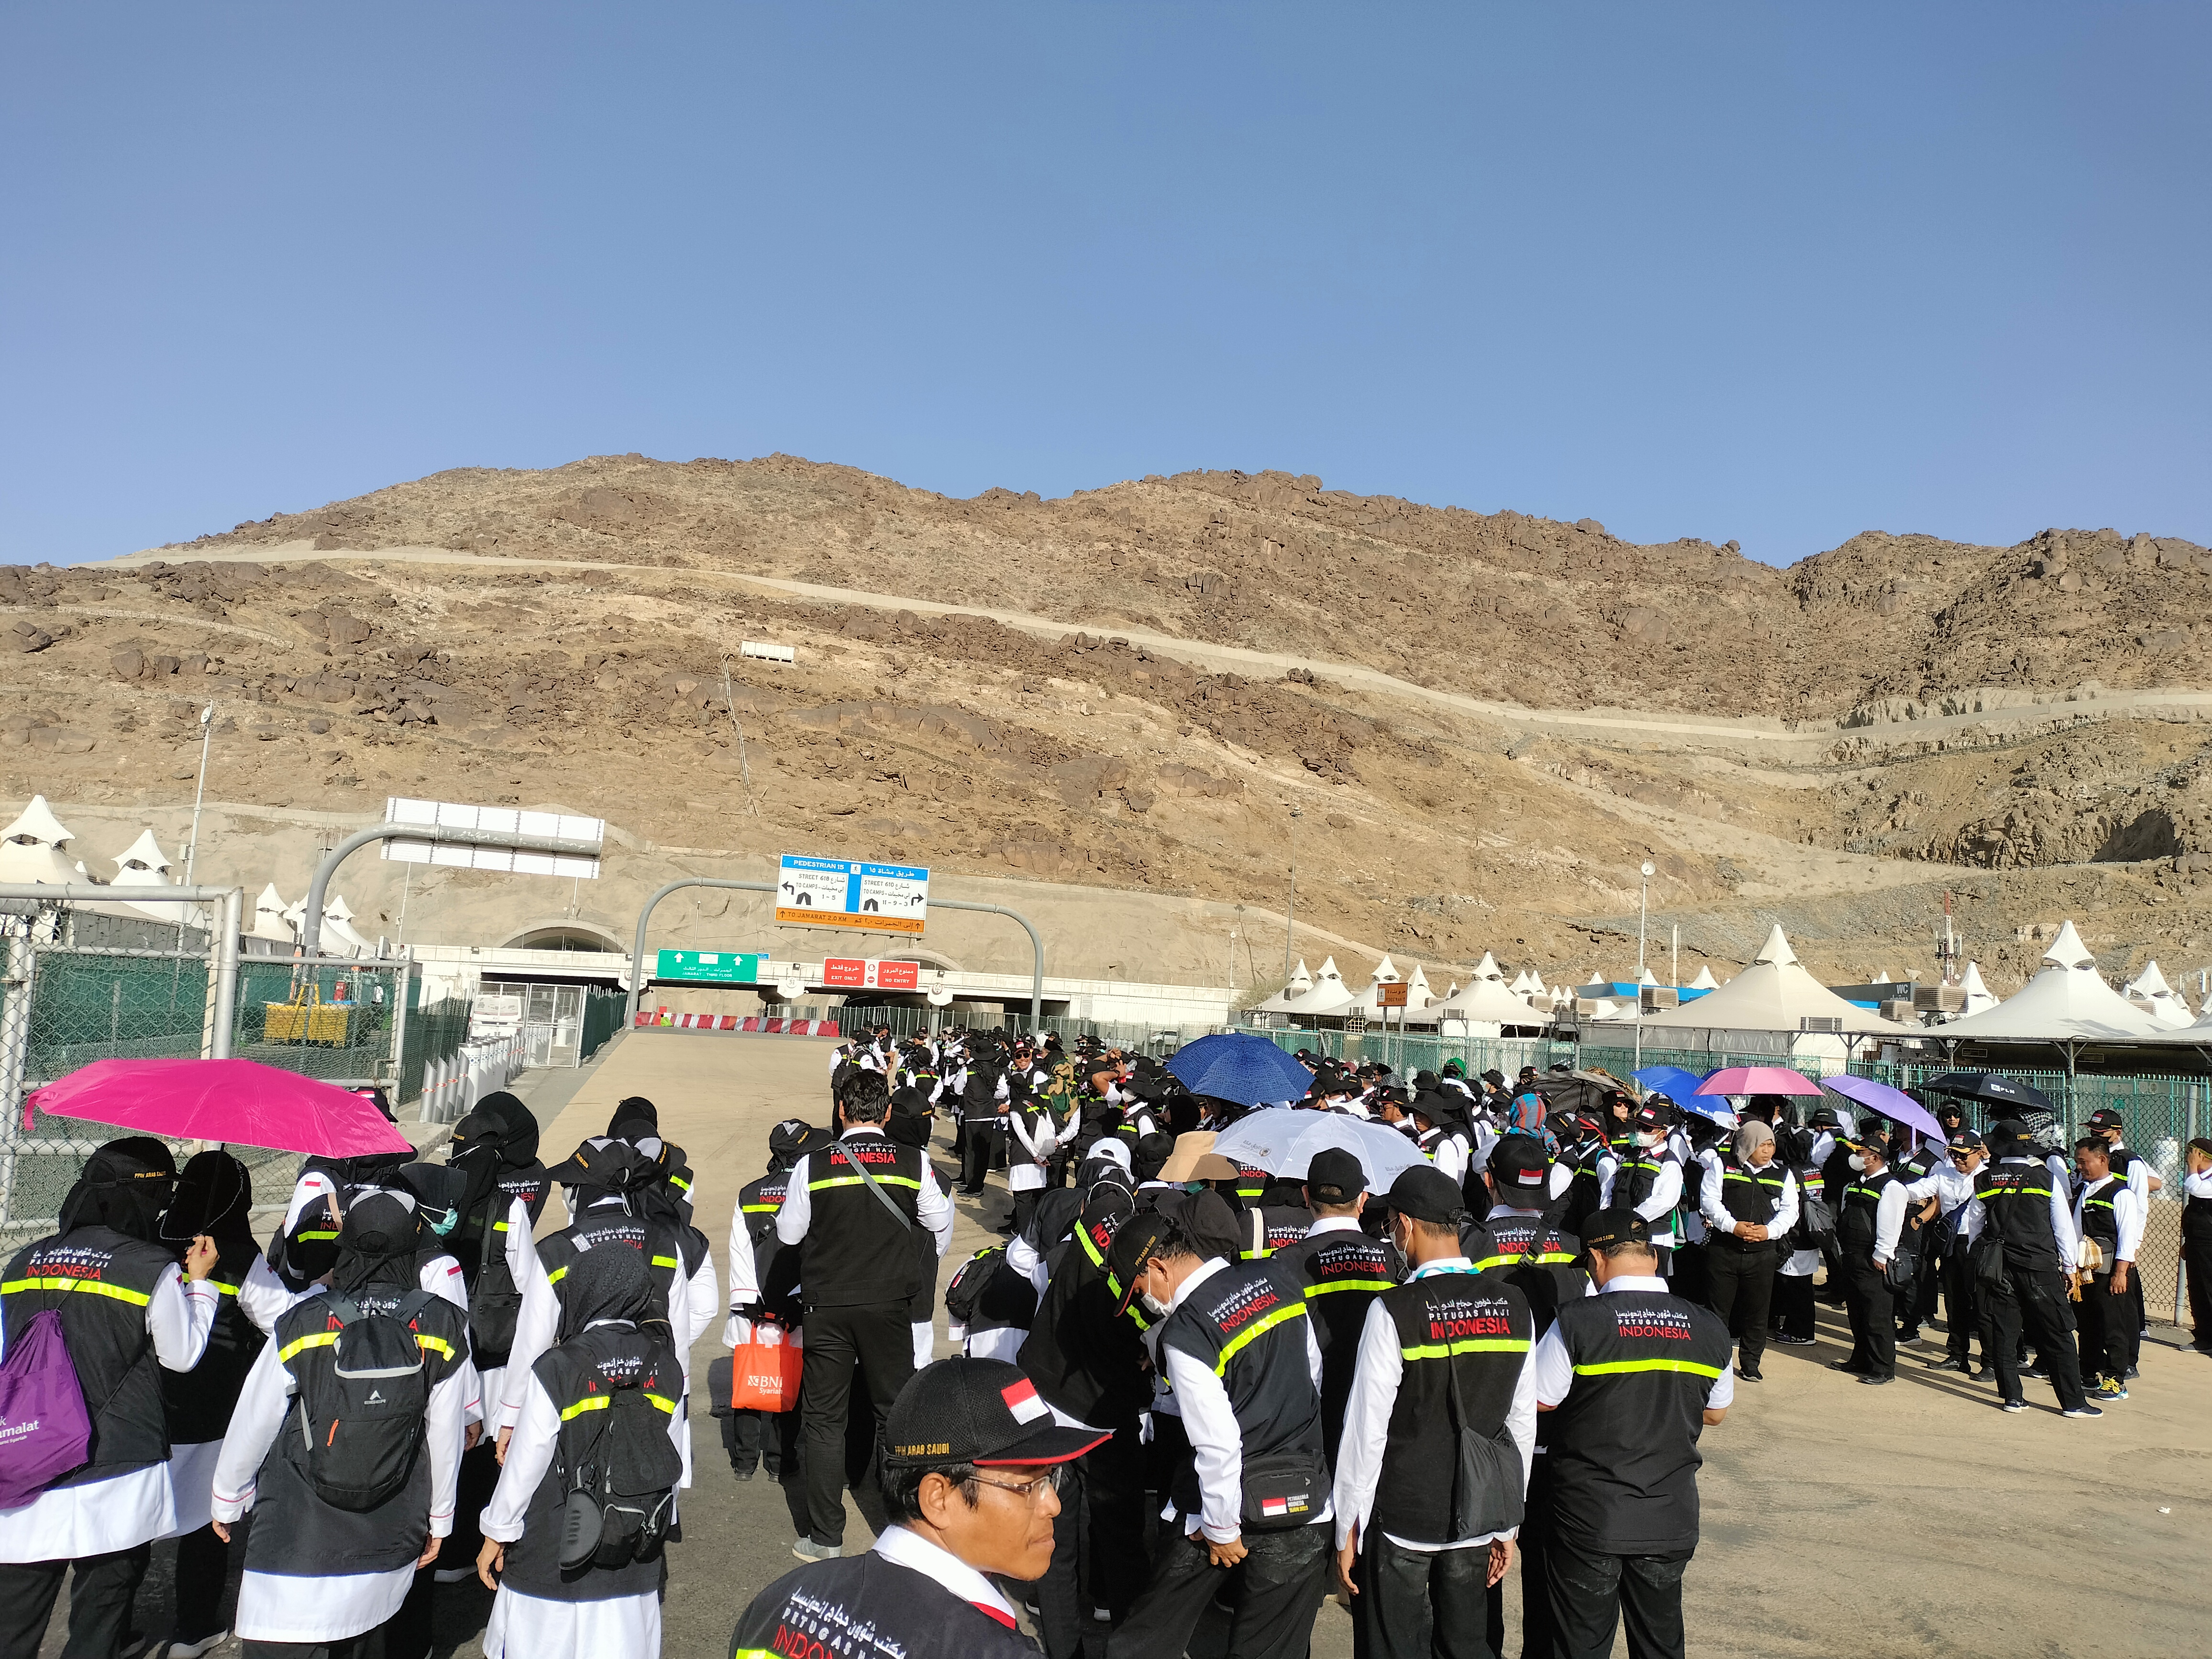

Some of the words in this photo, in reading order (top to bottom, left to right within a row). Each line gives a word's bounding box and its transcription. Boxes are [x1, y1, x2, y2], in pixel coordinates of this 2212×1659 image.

[794, 860, 836, 869] PEDESTRIAN
[1896, 984, 1908, 994] WC
[1320, 1254, 1362, 1264] PETUGAS
[1320, 1261, 1387, 1275] INDONESIA
[1214, 1295, 1252, 1323] PETUGAS
[1254, 1284, 1273, 1297] HAJI
[1219, 1292, 1280, 1333] INDONESIA
[1428, 1309, 1479, 1321] PETUGAS
[1485, 1308, 1509, 1316] HAJI
[1430, 1317, 1511, 1339] INDONESIA
[1668, 1320, 1691, 1328] HAJI
[1619, 1326, 1692, 1341] INDONESIA
[760, 1376, 783, 1388] BNI
[759, 1387, 783, 1395] Syariah
[907, 1444, 925, 1456] ARAB
[927, 1443, 950, 1455] SAUDI
[782, 1607, 852, 1655] PETUGAS
